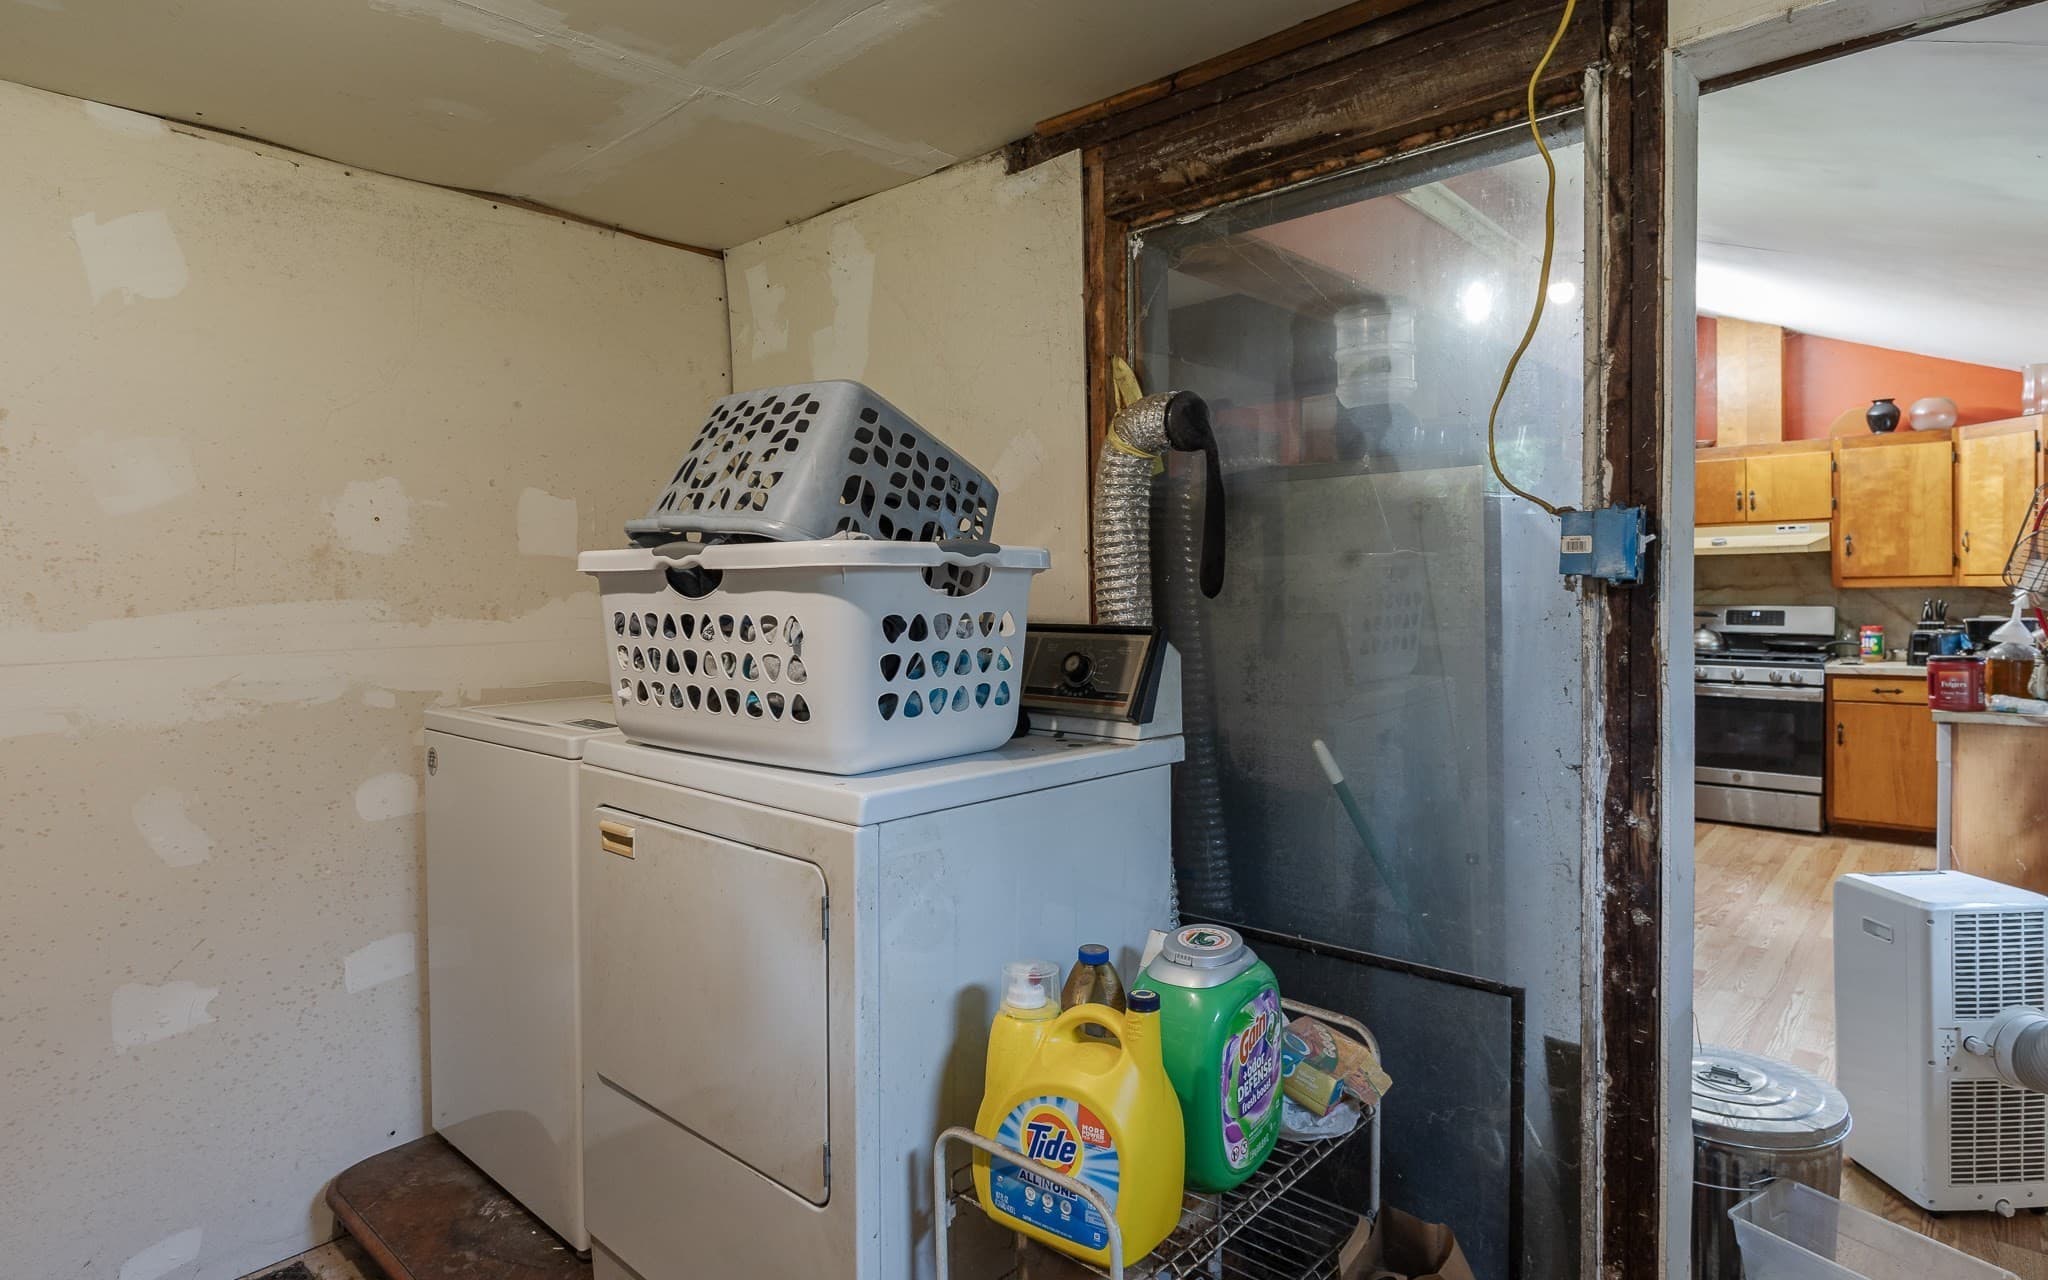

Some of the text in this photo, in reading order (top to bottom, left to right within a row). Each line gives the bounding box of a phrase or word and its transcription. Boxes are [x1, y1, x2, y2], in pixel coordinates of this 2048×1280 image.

[1240, 1011, 1266, 1065] Gain
[1238, 1057, 1272, 1102] DEFENSE
[1242, 1096, 1257, 1114] fresh
[1256, 1078, 1271, 1099] boost
[1026, 1122, 1077, 1163] Tide
[1082, 1124, 1105, 1135] MORE
[1020, 1170, 1040, 1185] ALL
[1040, 1178, 1051, 1190] IN
